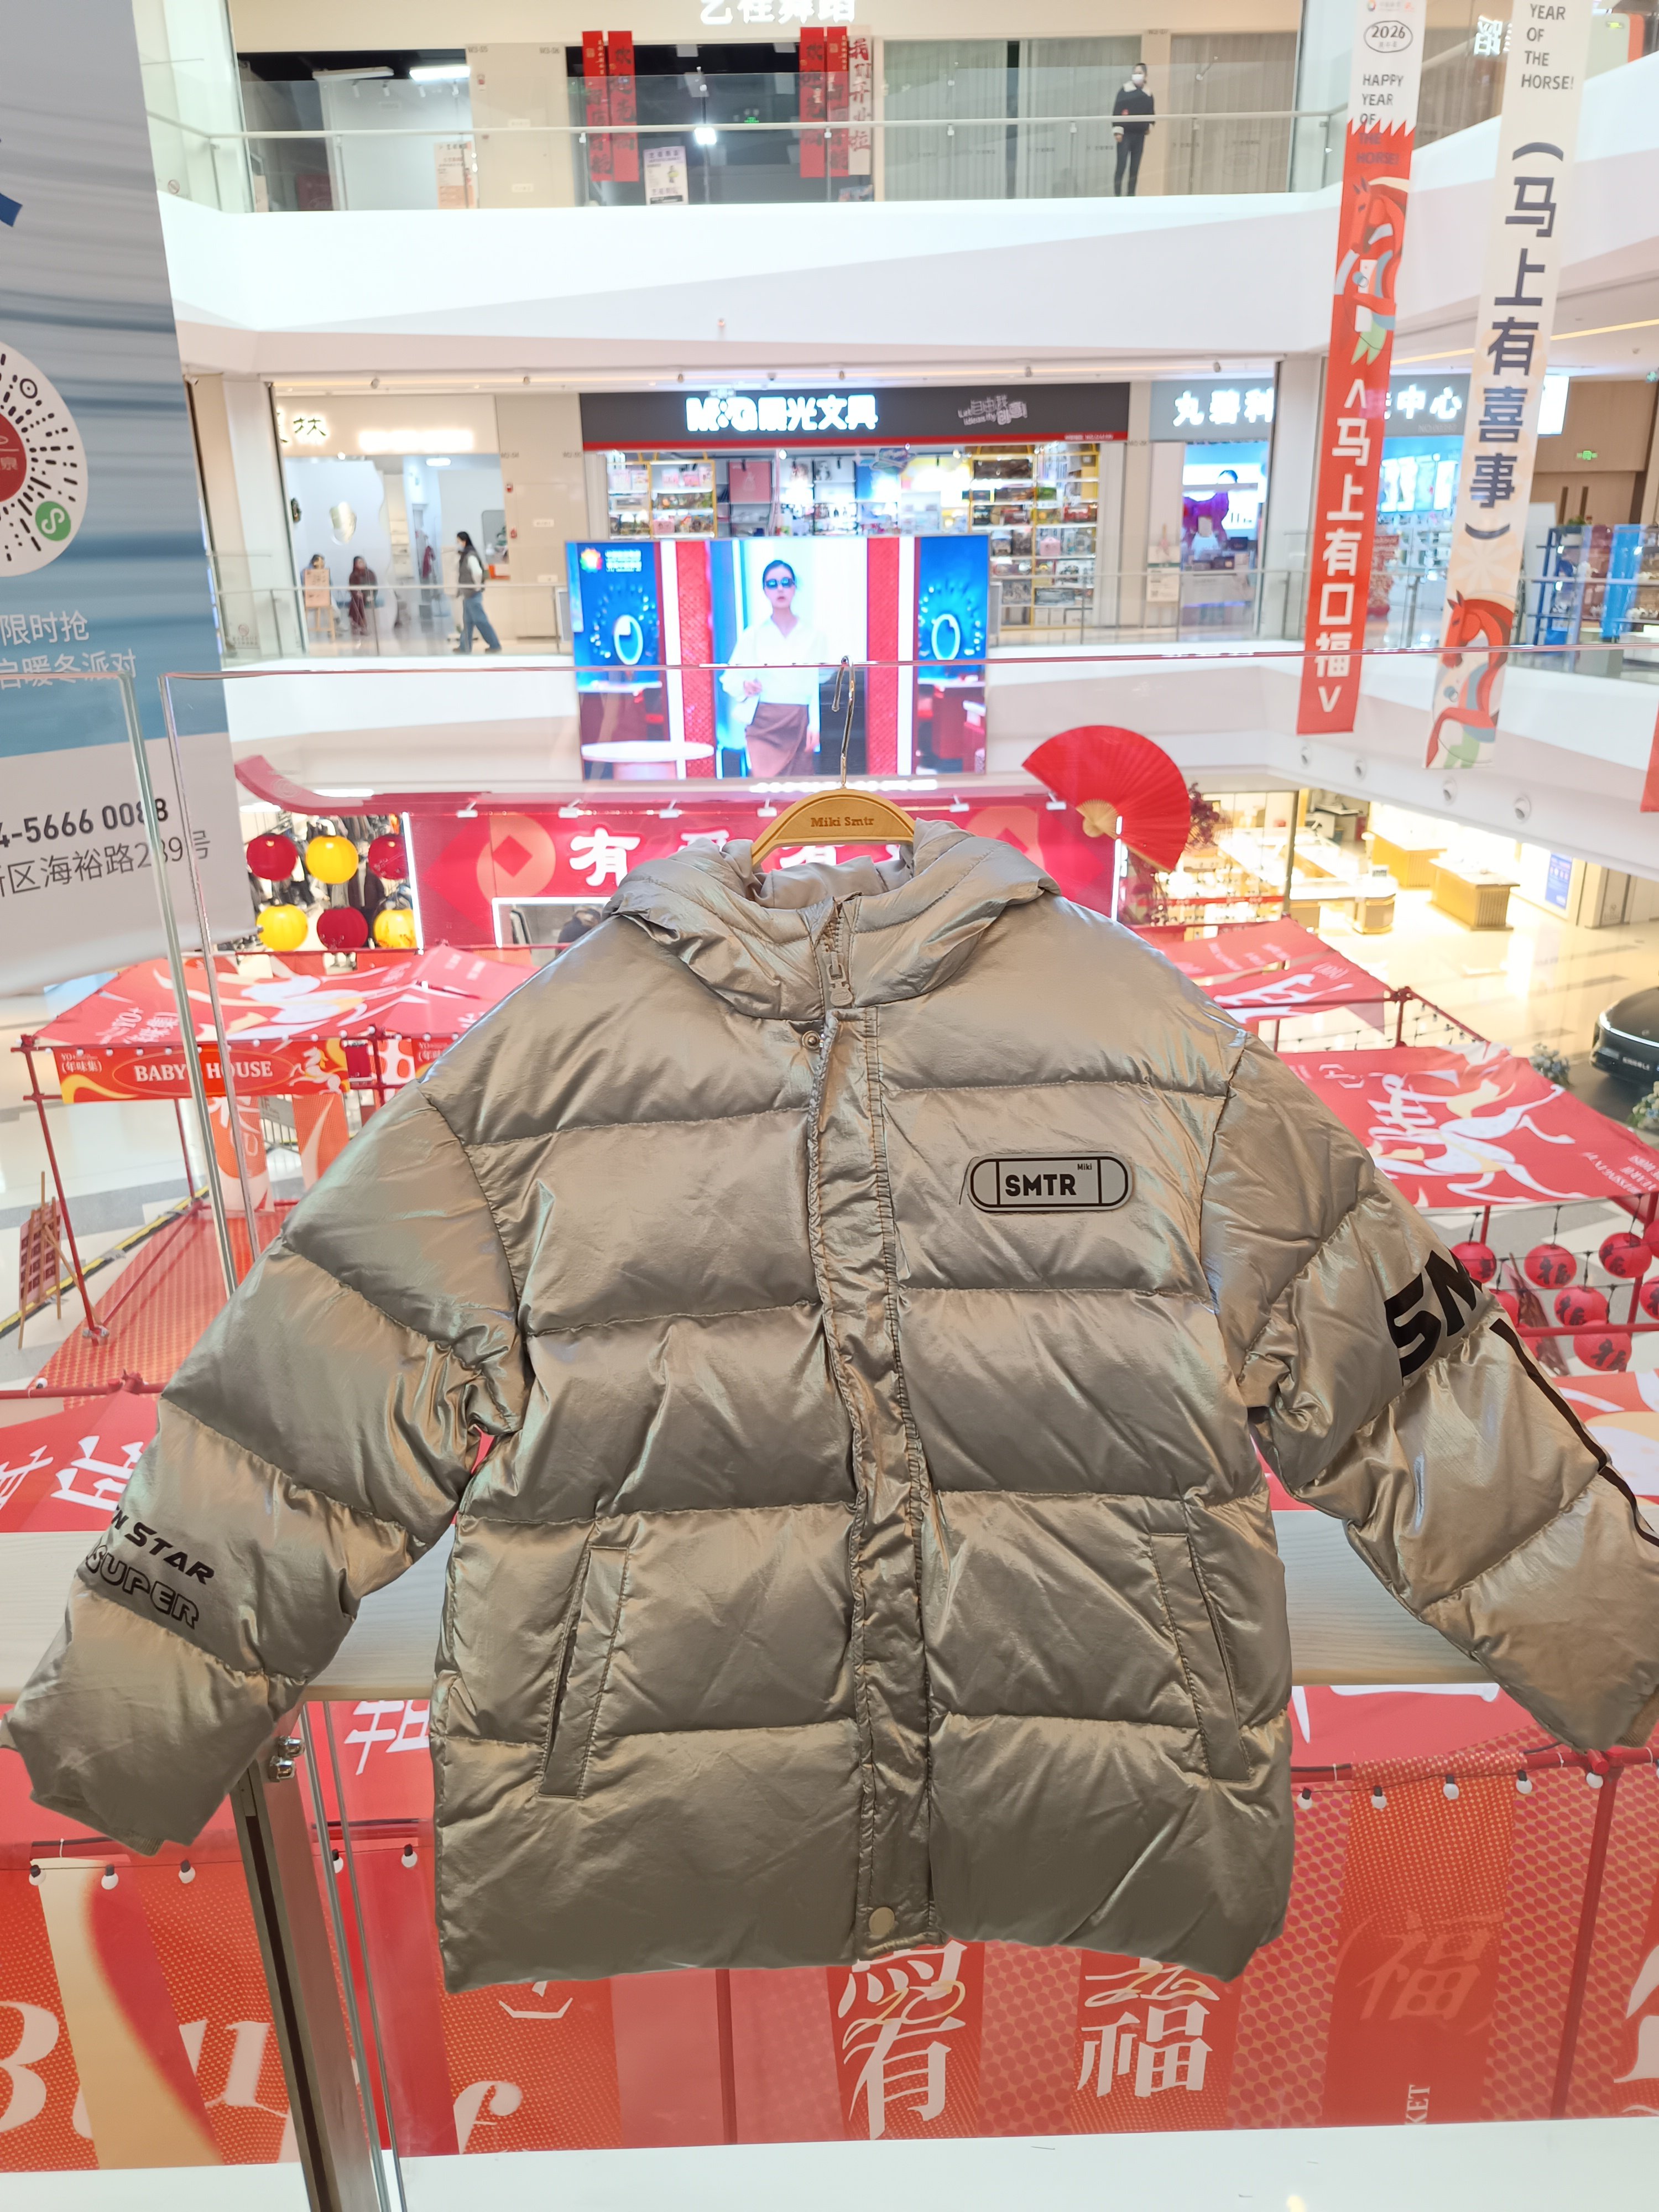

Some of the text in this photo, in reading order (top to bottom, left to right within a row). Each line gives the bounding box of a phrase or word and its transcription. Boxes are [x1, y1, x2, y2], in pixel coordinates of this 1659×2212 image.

[1530, 3, 1566, 20] YEAR
[1371, 25, 1405, 39] 2026
[1526, 27, 1545, 42] OF
[1524, 50, 1550, 66] THE
[1362, 73, 1404, 87] HAPPY
[1521, 74, 1574, 90] HORSE!
[1361, 93, 1394, 106] YEAR
[1360, 113, 1376, 126] OF
[1359, 132, 1381, 145] THE
[0, 610, 89, 646] 限时抢
[810, 815, 875, 828] Miki Smtr
[135, 1061, 274, 1083] BABY HOUSE
[1077, 1162, 1093, 1171] Miki
[1005, 1173, 1077, 1197] SMTR
[124, 1521, 215, 1585] STAR
[85, 1544, 200, 1630] SUPER
